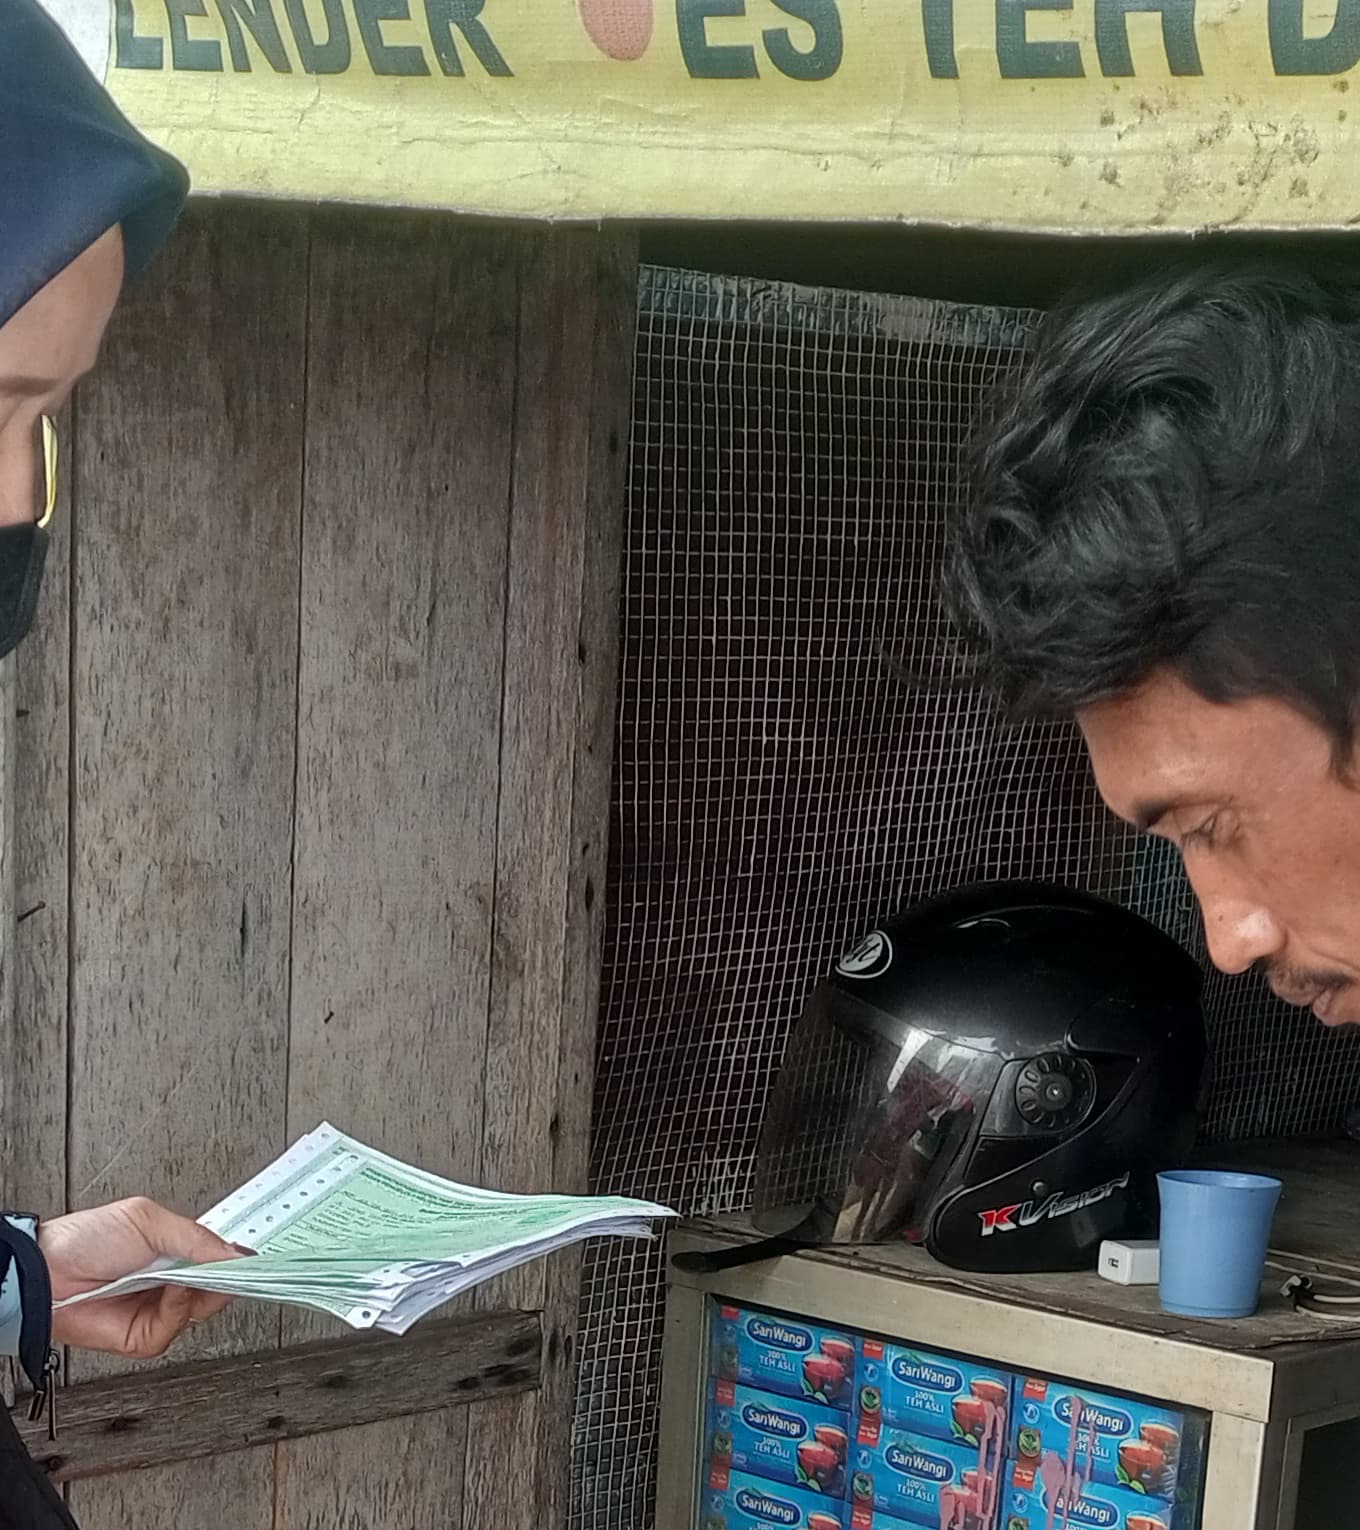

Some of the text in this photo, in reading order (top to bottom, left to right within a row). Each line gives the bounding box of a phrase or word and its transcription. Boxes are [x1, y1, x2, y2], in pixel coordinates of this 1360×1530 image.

[676, 0, 844, 81] ES
[752, 1321, 807, 1349] SariWangi
[898, 1361, 956, 1389] SariWangi
[747, 1408, 801, 1436] SariWangi
[1061, 1402, 1124, 1432] SiWangi
[891, 1449, 947, 1478] SariWangi
[741, 1494, 795, 1522] SariWangi
